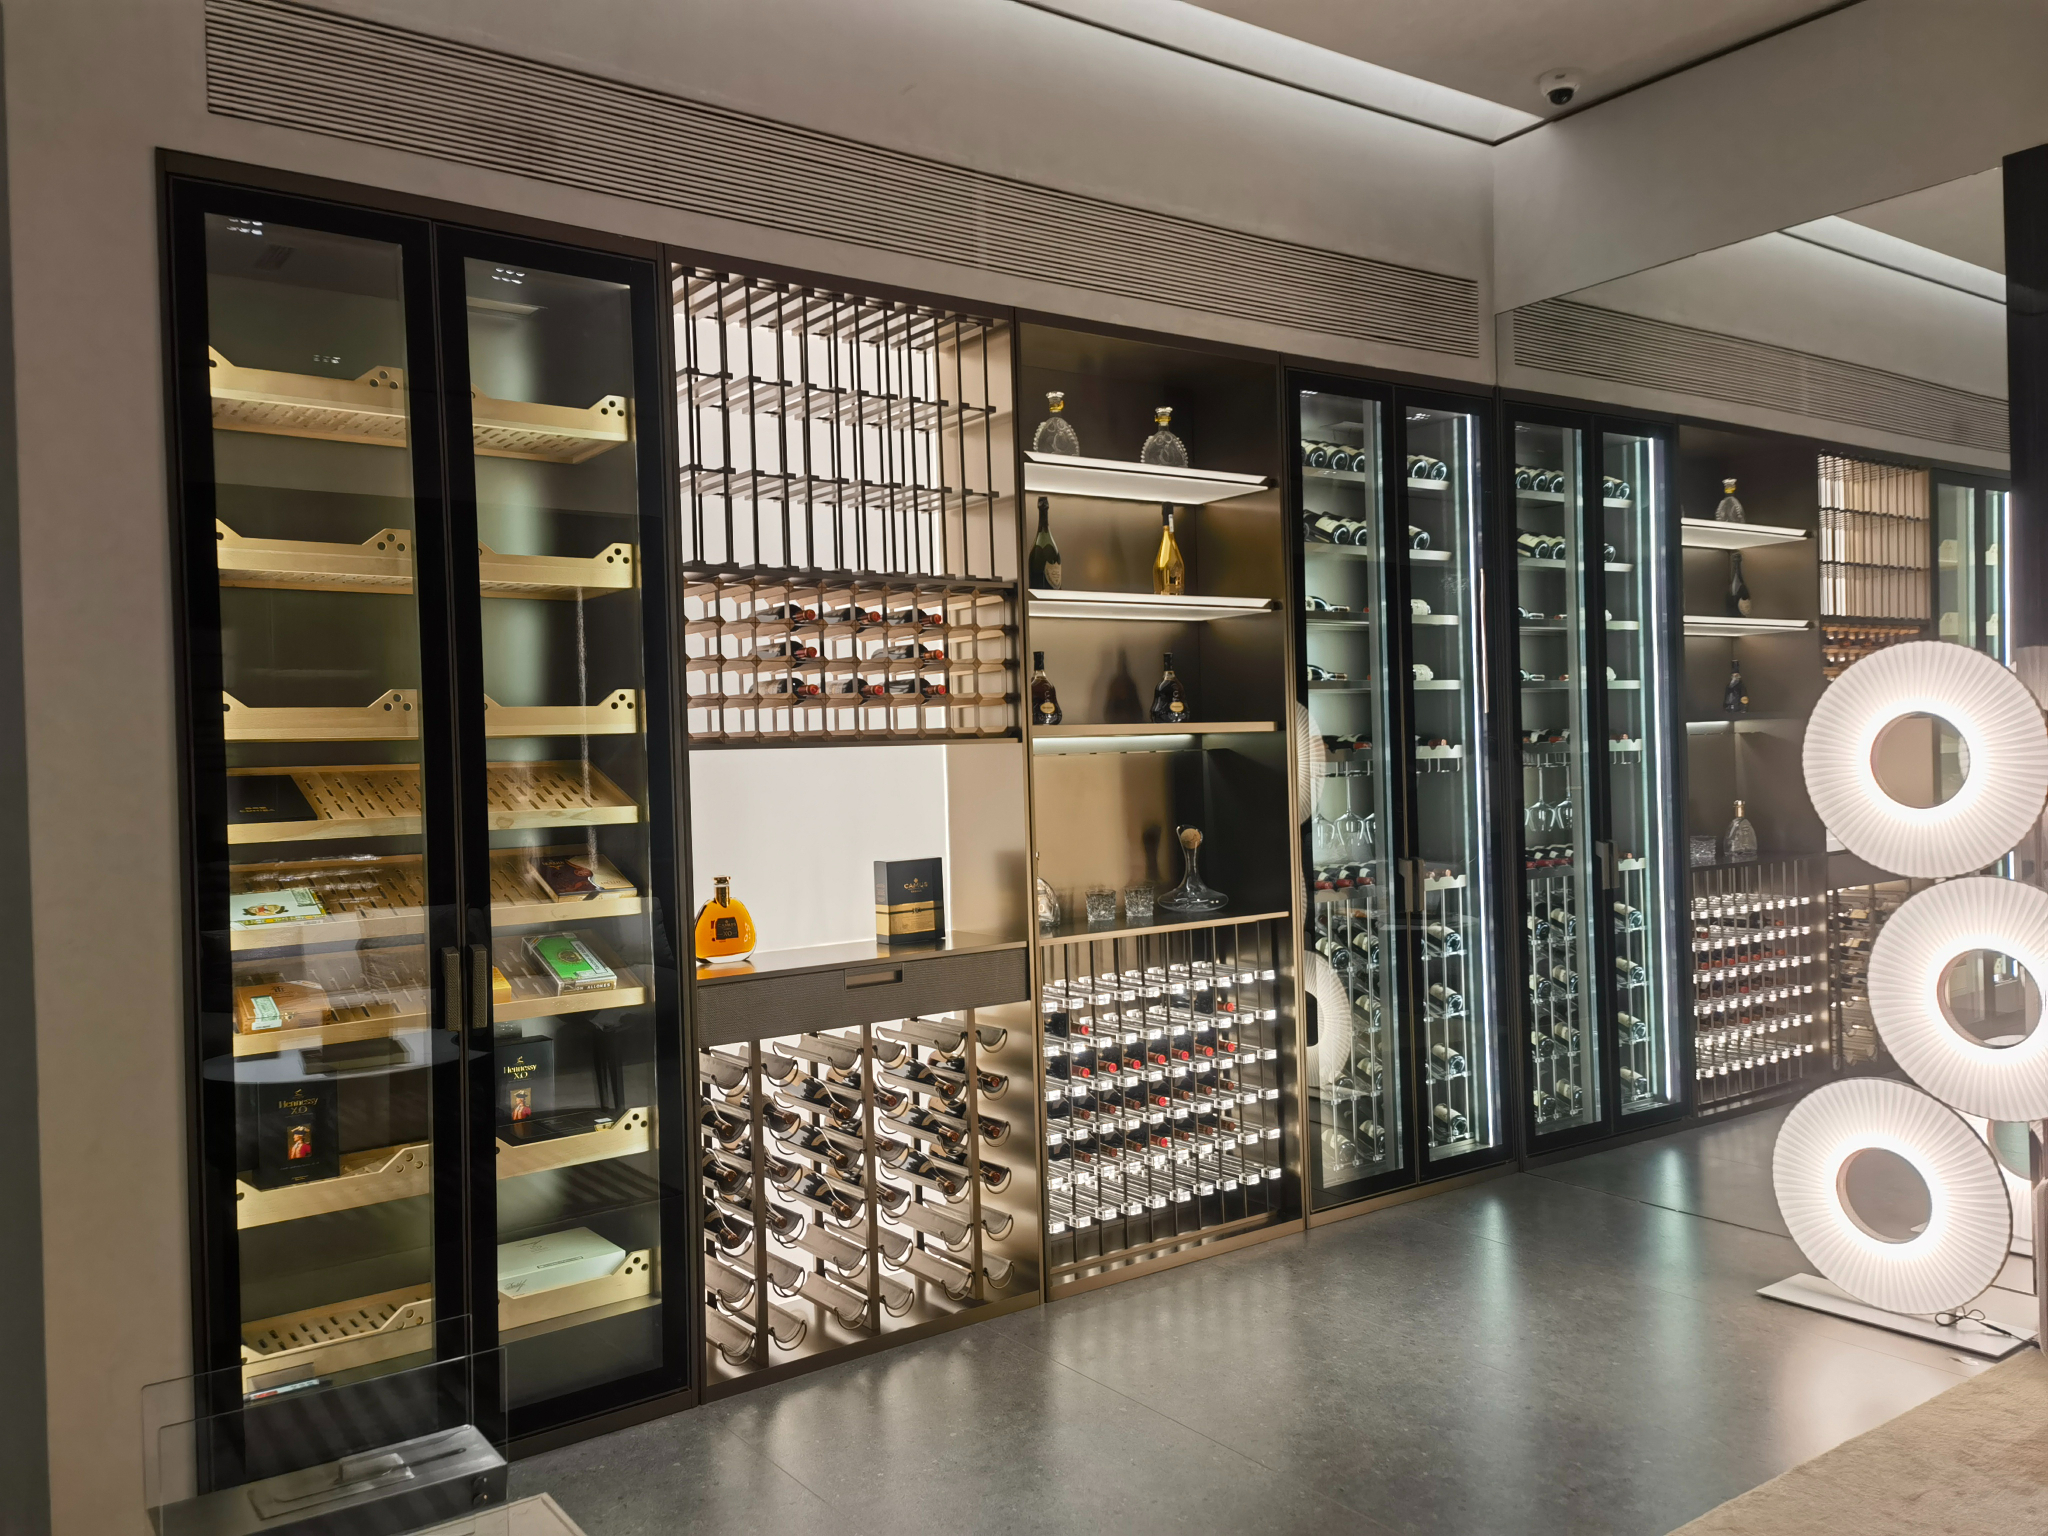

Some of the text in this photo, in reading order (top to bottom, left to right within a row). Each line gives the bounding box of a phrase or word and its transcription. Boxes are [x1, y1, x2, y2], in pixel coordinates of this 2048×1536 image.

[903, 881, 928, 889] CAMUS
[503, 1064, 537, 1074] Hennessy
[278, 1097, 318, 1108] Hennessy
